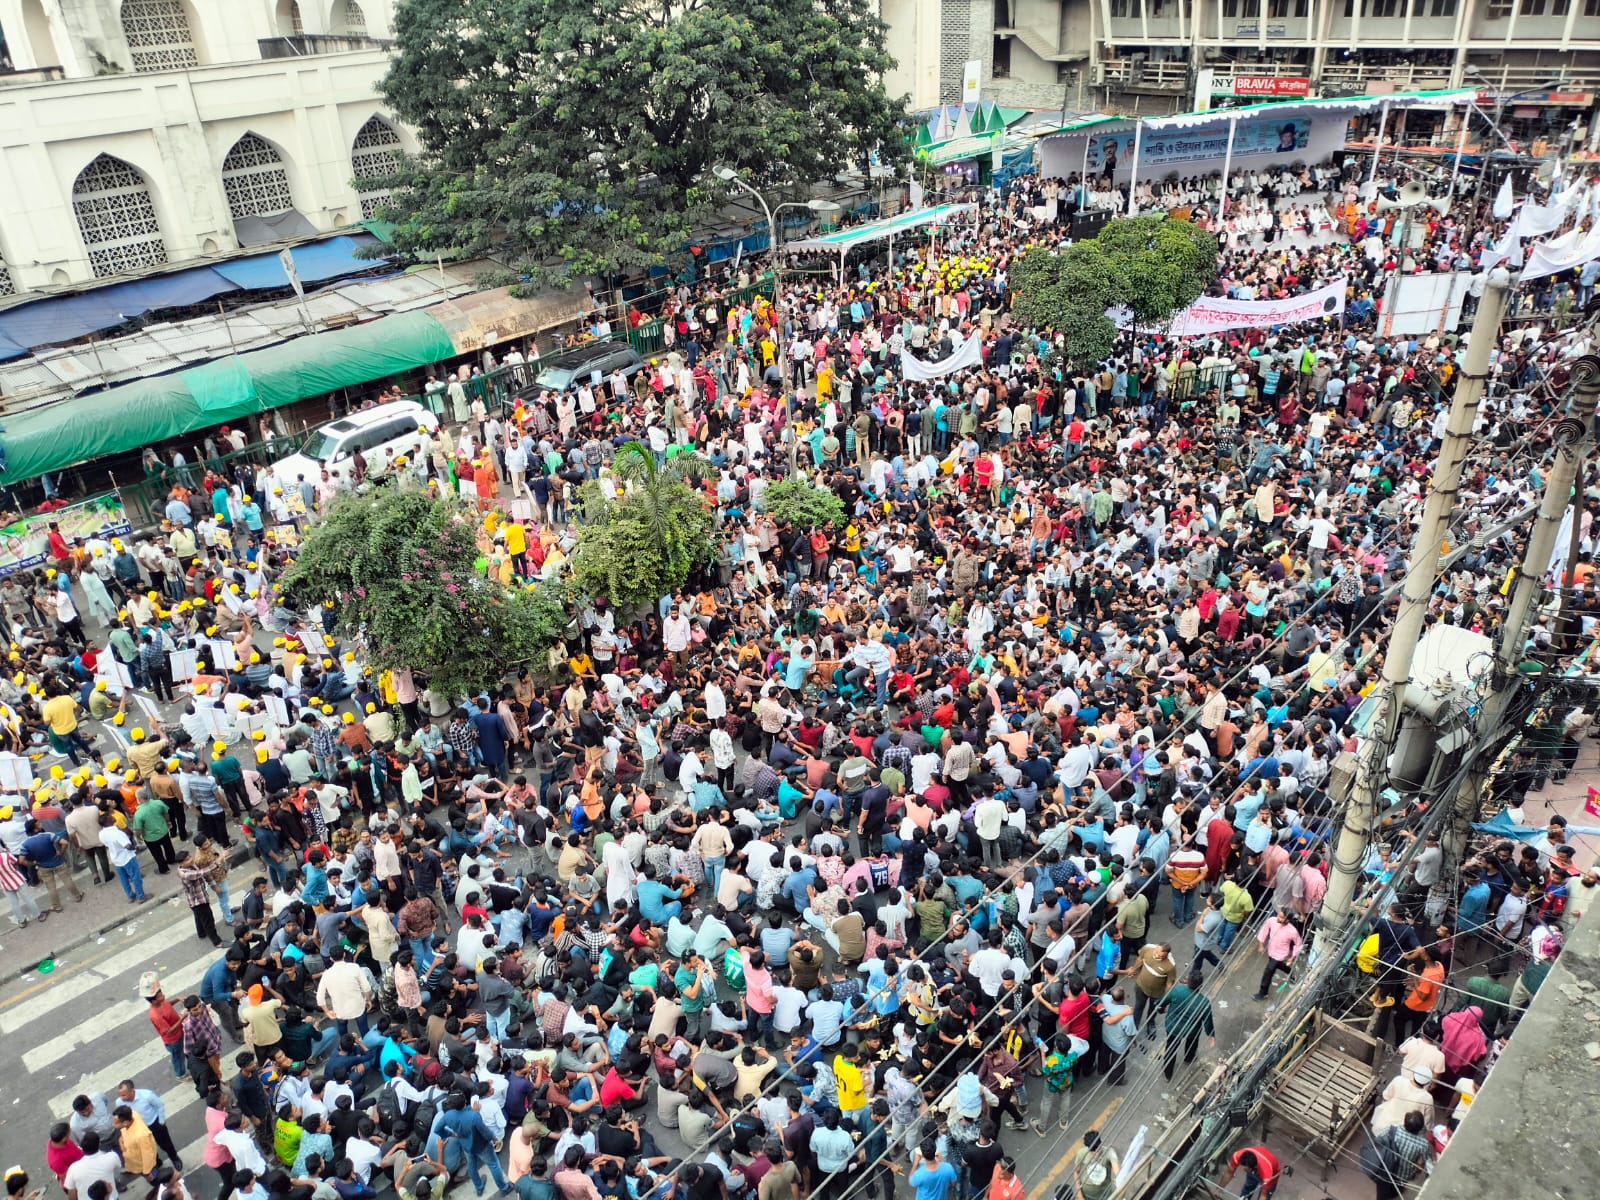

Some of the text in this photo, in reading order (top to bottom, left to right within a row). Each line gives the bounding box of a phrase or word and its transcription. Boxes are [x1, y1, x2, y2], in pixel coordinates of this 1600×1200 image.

[1237, 78, 1276, 89] BRAVIA
[1341, 82, 1366, 91] SONY
[1145, 141, 1165, 156] শান্তি
[1166, 143, 1174, 154] ও
